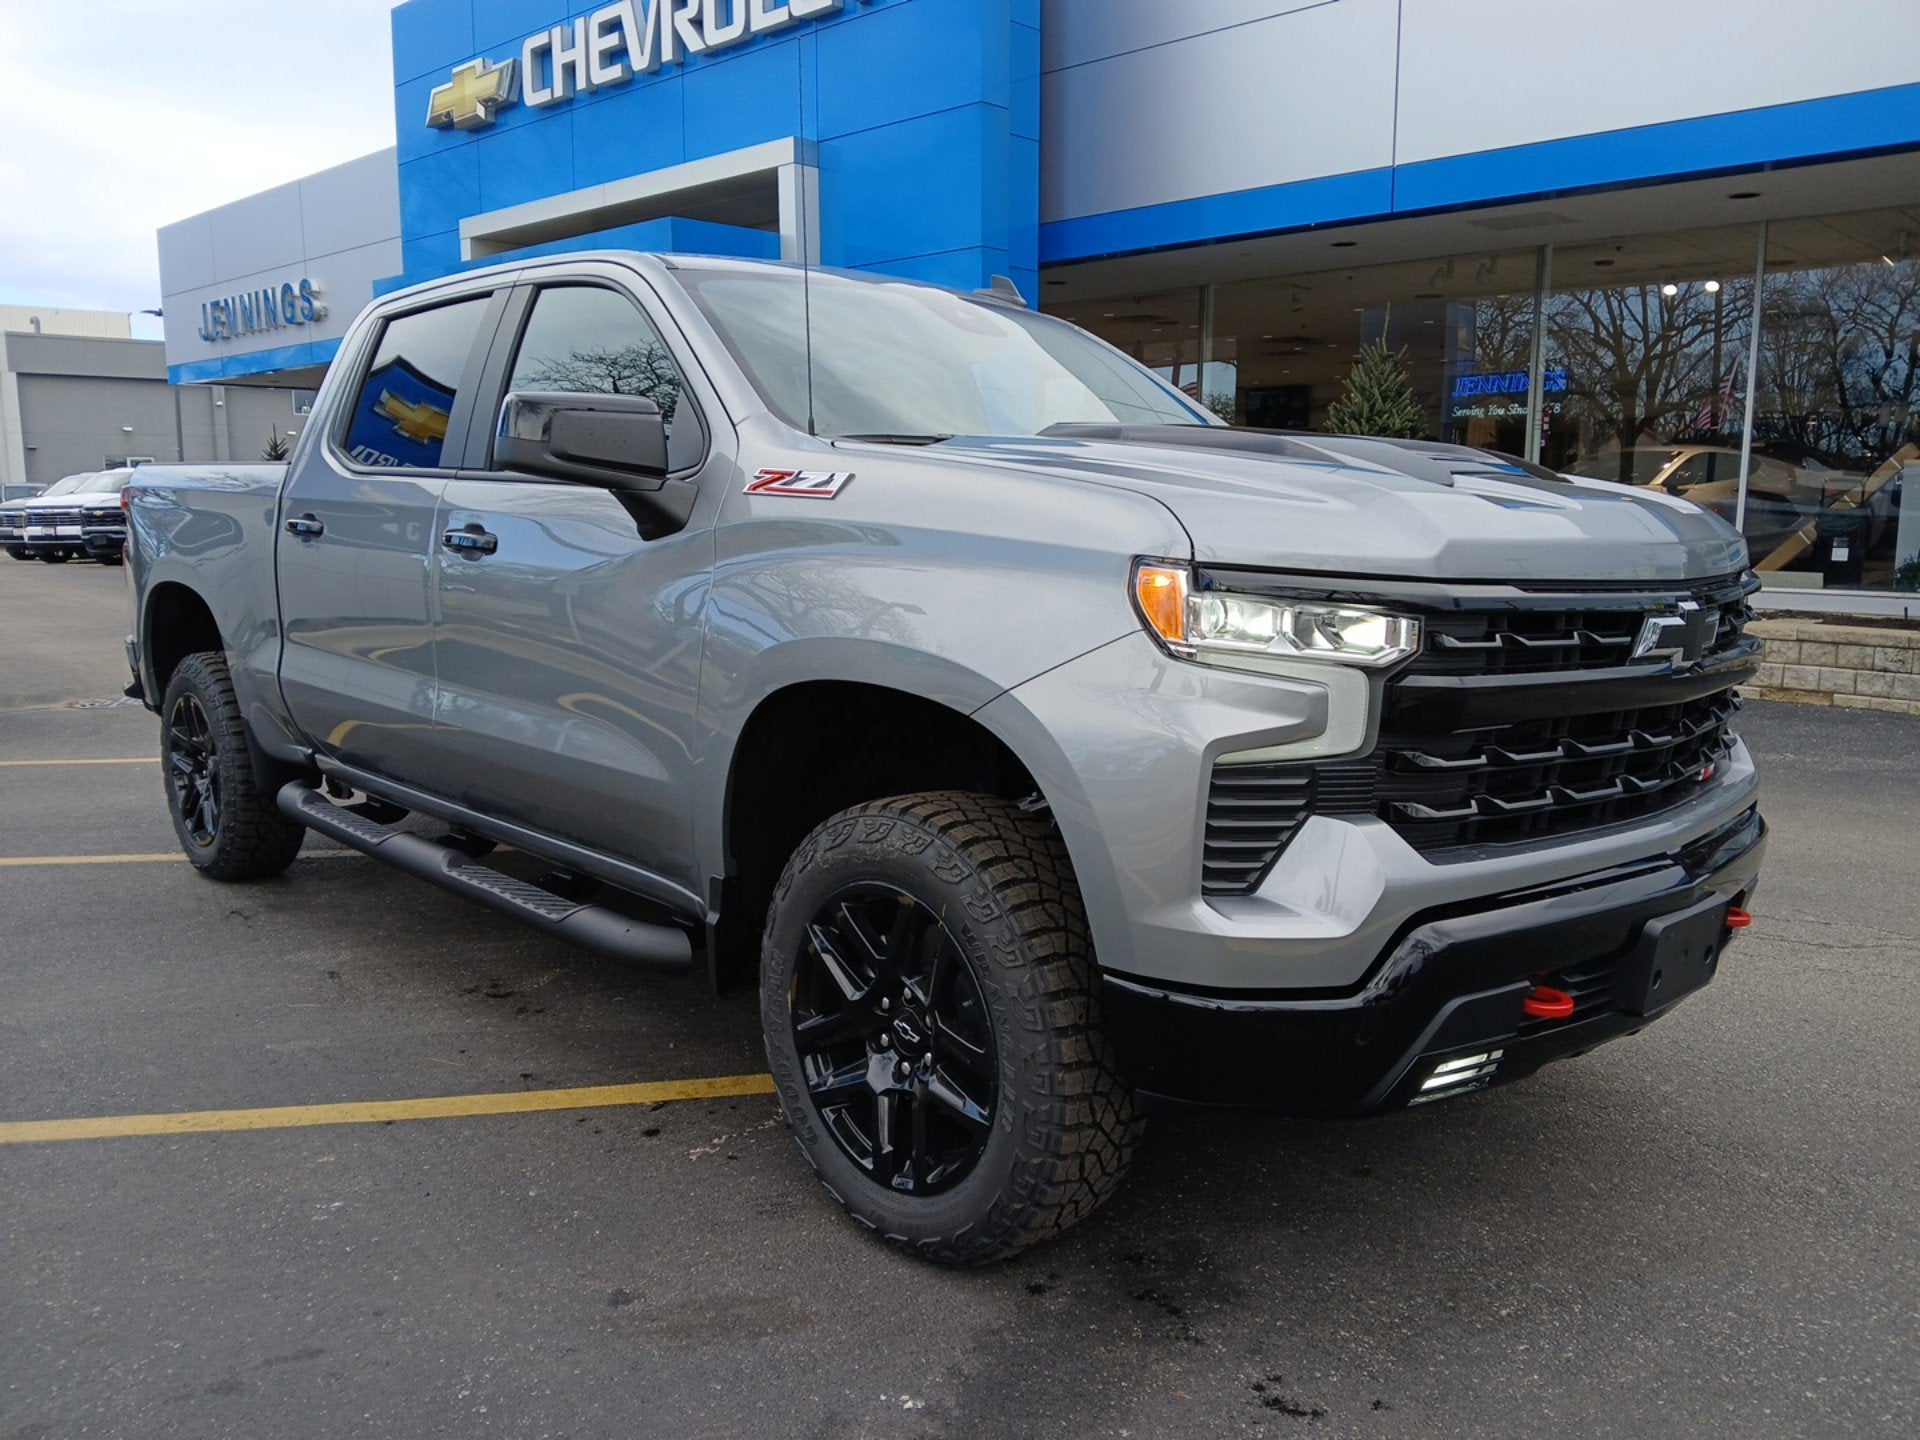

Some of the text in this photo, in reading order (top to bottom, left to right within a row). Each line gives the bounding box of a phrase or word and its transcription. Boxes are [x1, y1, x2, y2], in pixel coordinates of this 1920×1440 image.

[199, 278, 319, 342] JENNINGS
[1452, 405, 1485, 418] Serving
[1488, 404, 1505, 416] You
[742, 467, 856, 499] Z71
